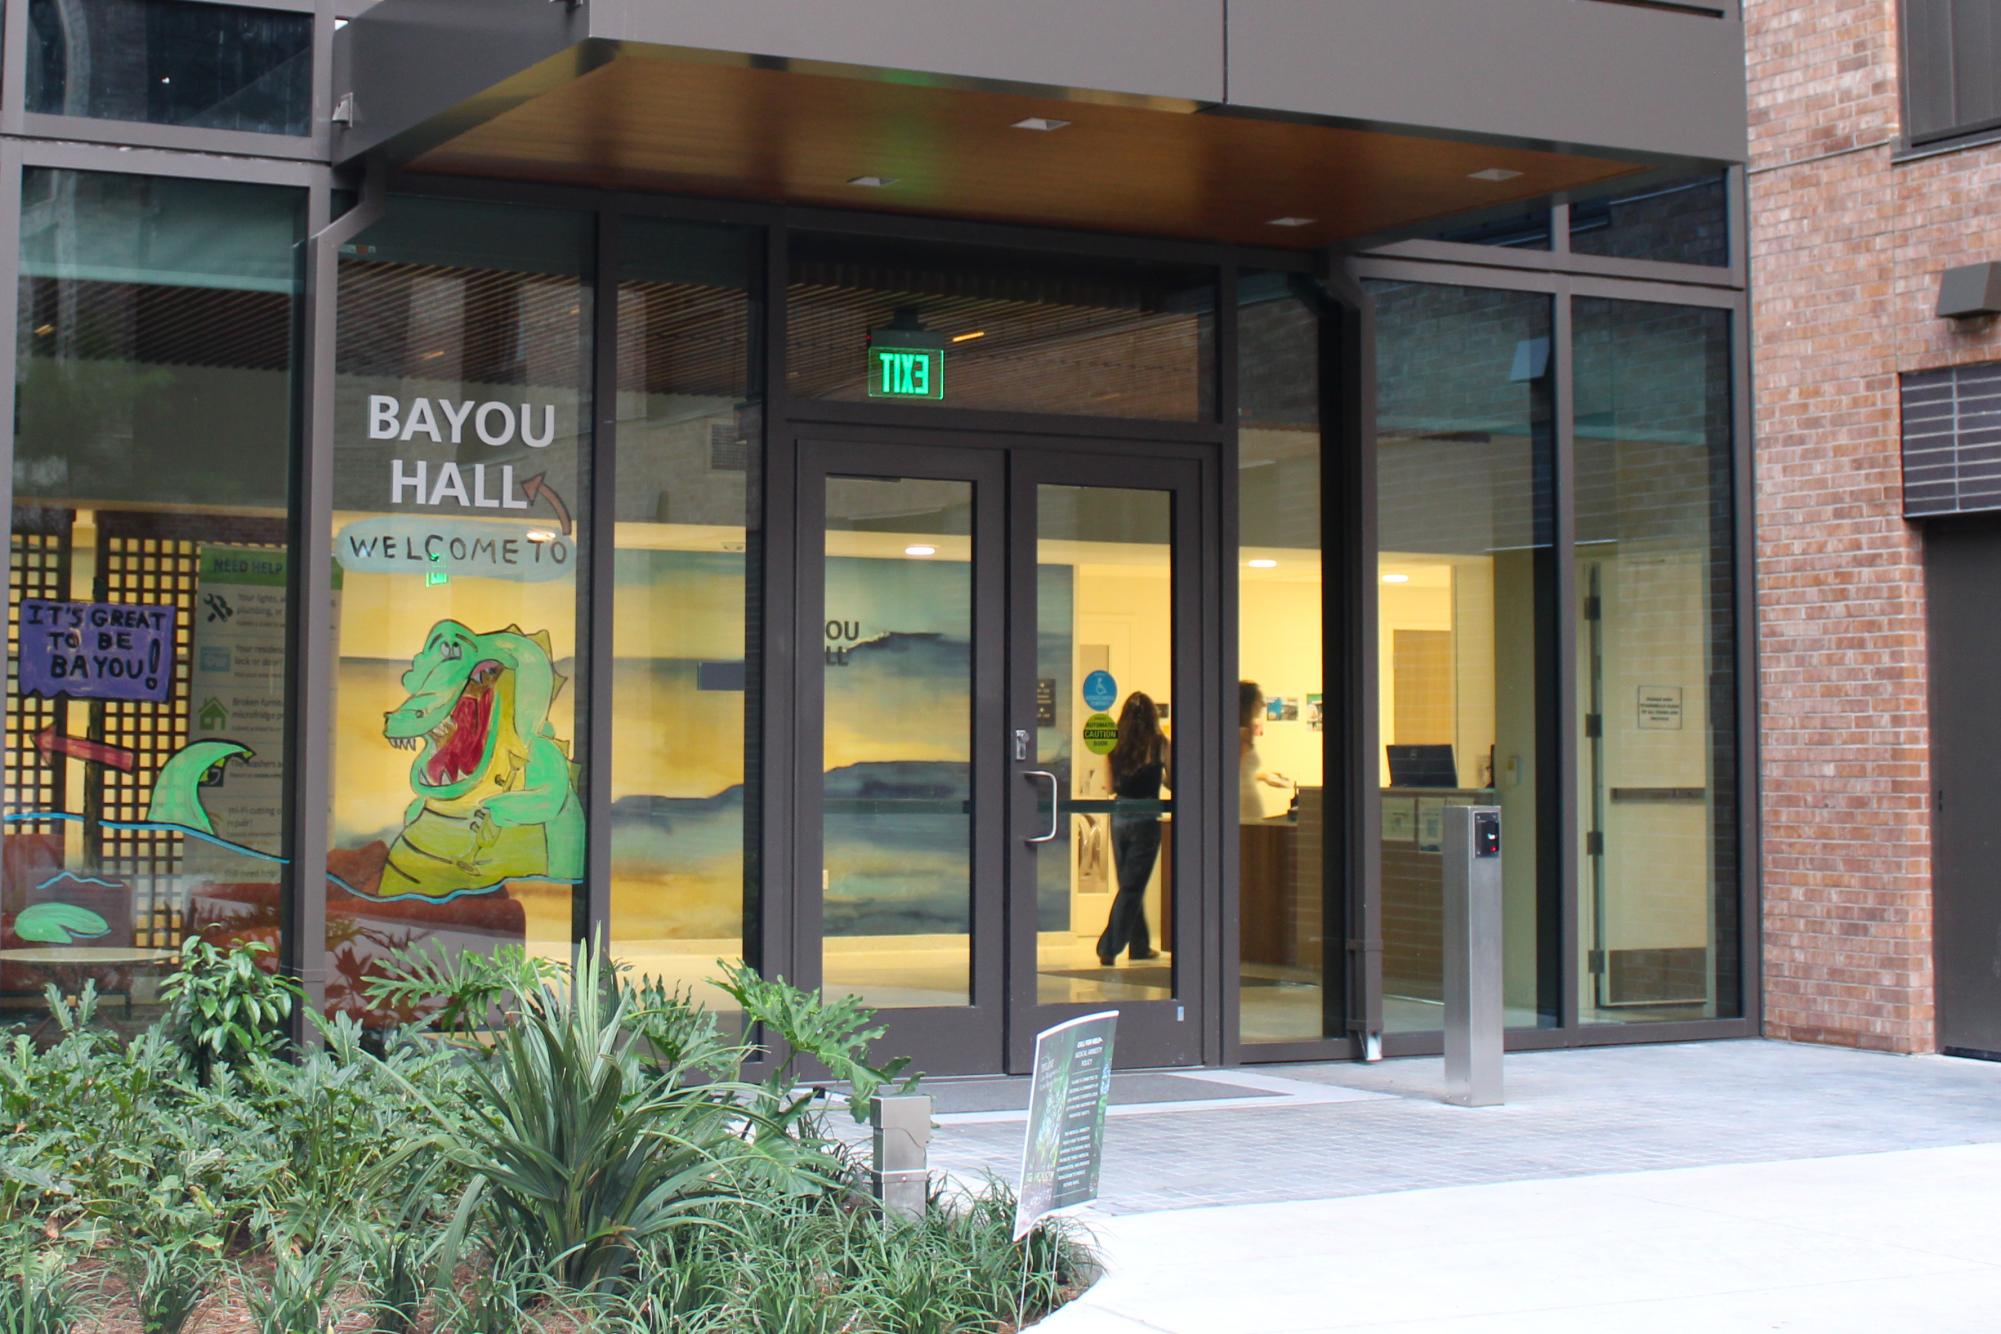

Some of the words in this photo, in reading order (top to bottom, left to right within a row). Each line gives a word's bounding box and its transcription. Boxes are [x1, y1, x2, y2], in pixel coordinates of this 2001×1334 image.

[369, 394, 555, 448] BAYOU
[391, 459, 528, 510] HALL
[350, 535, 518, 564] WELCOME
[527, 539, 567, 564] TO
[213, 558, 248, 573] NEED
[252, 560, 282, 574] HELP
[27, 604, 83, 627] IT'S
[91, 608, 166, 631] GREAT
[48, 631, 80, 650] TO
[98, 632, 132, 650] BE
[51, 638, 160, 690] BAYOU!
[1084, 730, 1117, 739] CAUTION
